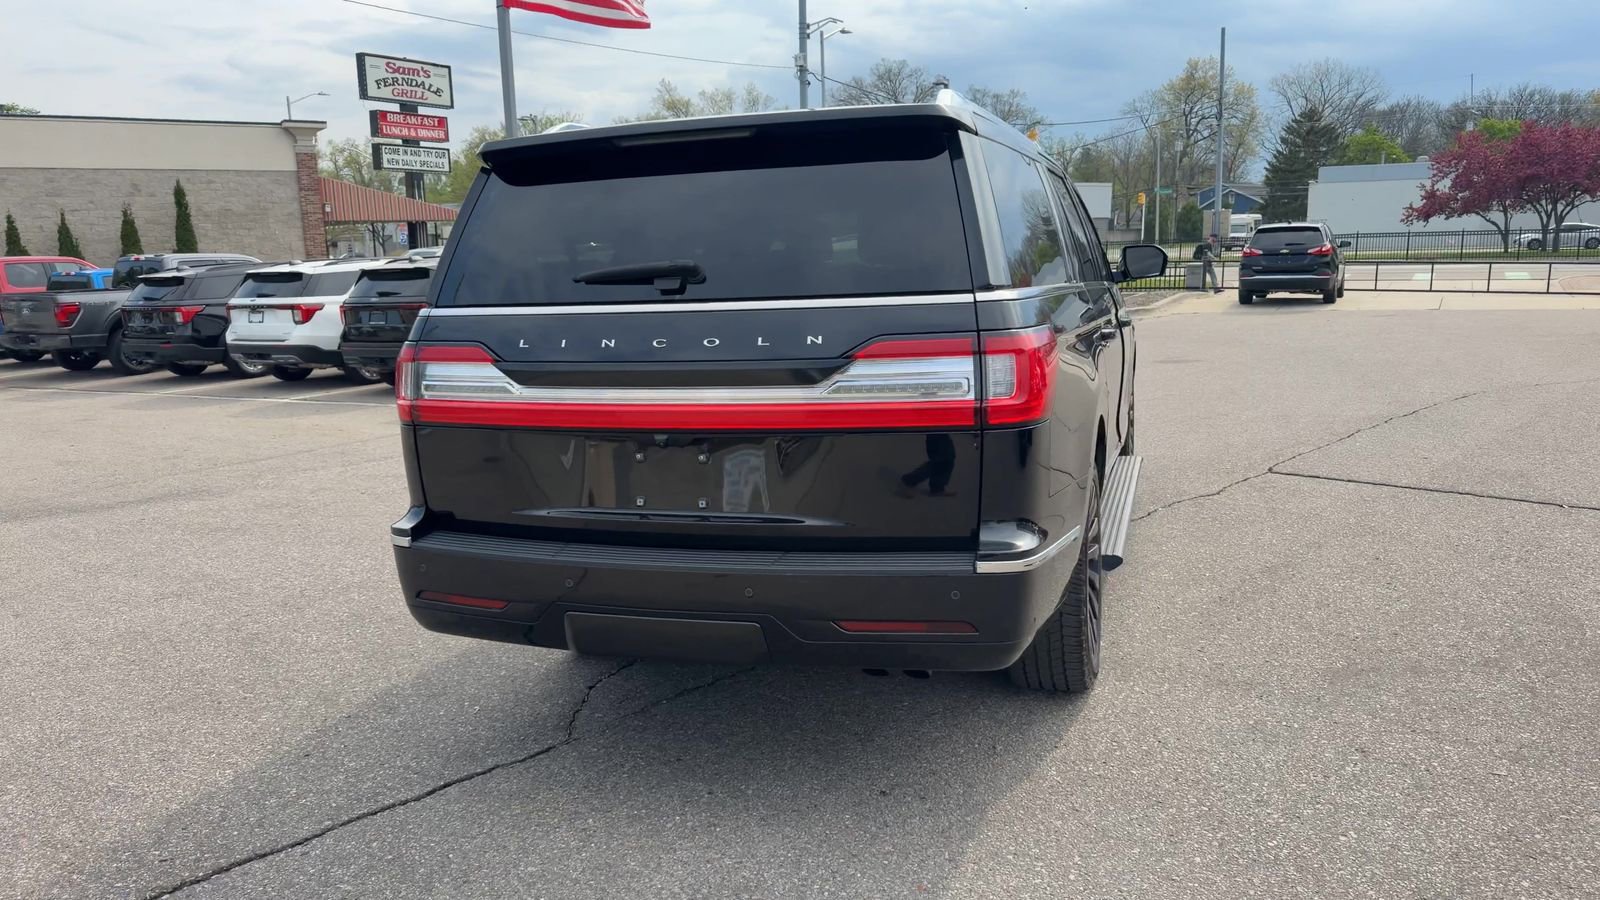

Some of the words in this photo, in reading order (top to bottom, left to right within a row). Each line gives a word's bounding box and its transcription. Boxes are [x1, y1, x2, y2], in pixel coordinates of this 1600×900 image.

[385, 61, 431, 79] Sam's
[374, 76, 444, 97] FERNDALE
[391, 87, 428, 101] GRILL
[386, 113, 439, 126] BREAKFAST
[382, 125, 409, 136] LUNCH
[410, 128, 416, 137] &
[417, 128, 445, 139] DINNER
[384, 147, 400, 156] COME
[402, 148, 409, 157] IN
[410, 149, 421, 157] AND
[423, 150, 433, 158] TRY
[434, 151, 446, 159] OUR
[386, 158, 400, 166] NEW
[401, 159, 418, 168] DAILY
[419, 161, 445, 169] SPECIALS
[519, 335, 823, 349] LINCOLN
